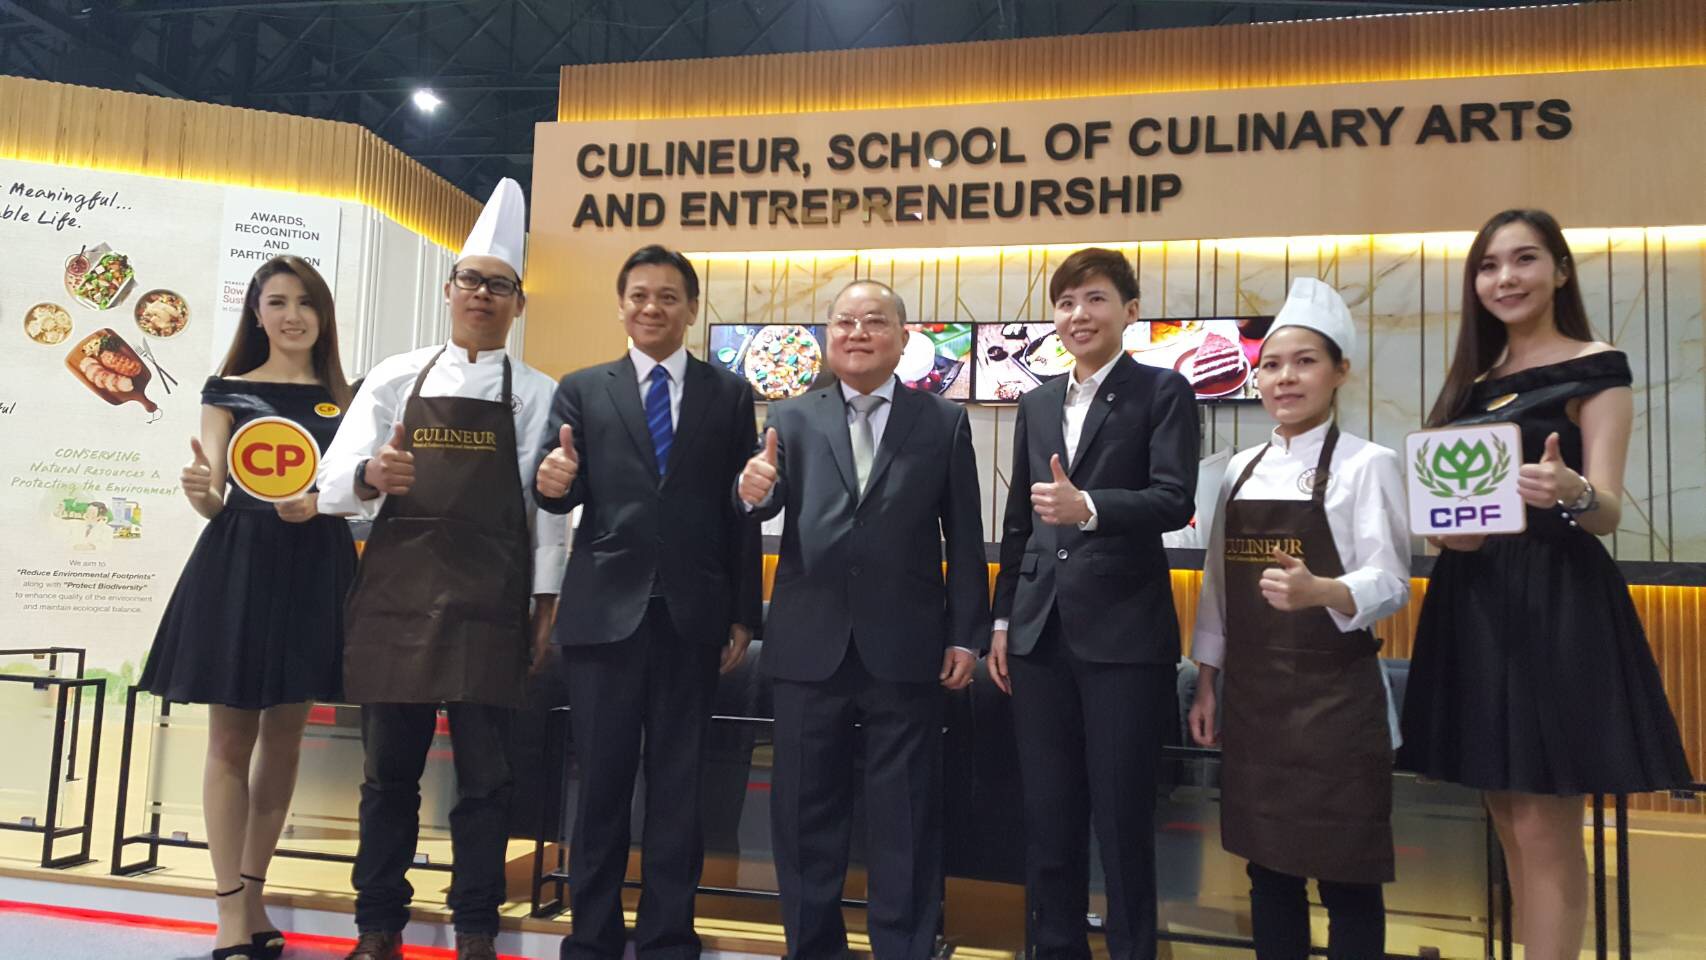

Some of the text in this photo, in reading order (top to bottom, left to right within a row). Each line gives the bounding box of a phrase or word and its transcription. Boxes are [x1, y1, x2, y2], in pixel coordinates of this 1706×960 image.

[577, 99, 1573, 178] CULINEUR, SCHOOL OF CULINARY ARTS
[573, 173, 1182, 228] AND ENTREPRENEURSHIP
[0, 204, 81, 231] ble Life.
[250, 212, 306, 228] AWARDS,
[235, 223, 320, 241] RECOGNITION
[264, 239, 290, 250] AND
[223, 286, 245, 295] Dow
[413, 428, 497, 445] CULINEUR
[55, 448, 141, 463] CONSERVING
[241, 442, 306, 477] CP
[30, 462, 81, 475] Natural
[84, 465, 145, 478] Resources
[11, 477, 180, 496] Protecting the Environment
[1430, 504, 1502, 529] CPF
[53, 570, 110, 579] Environmental
